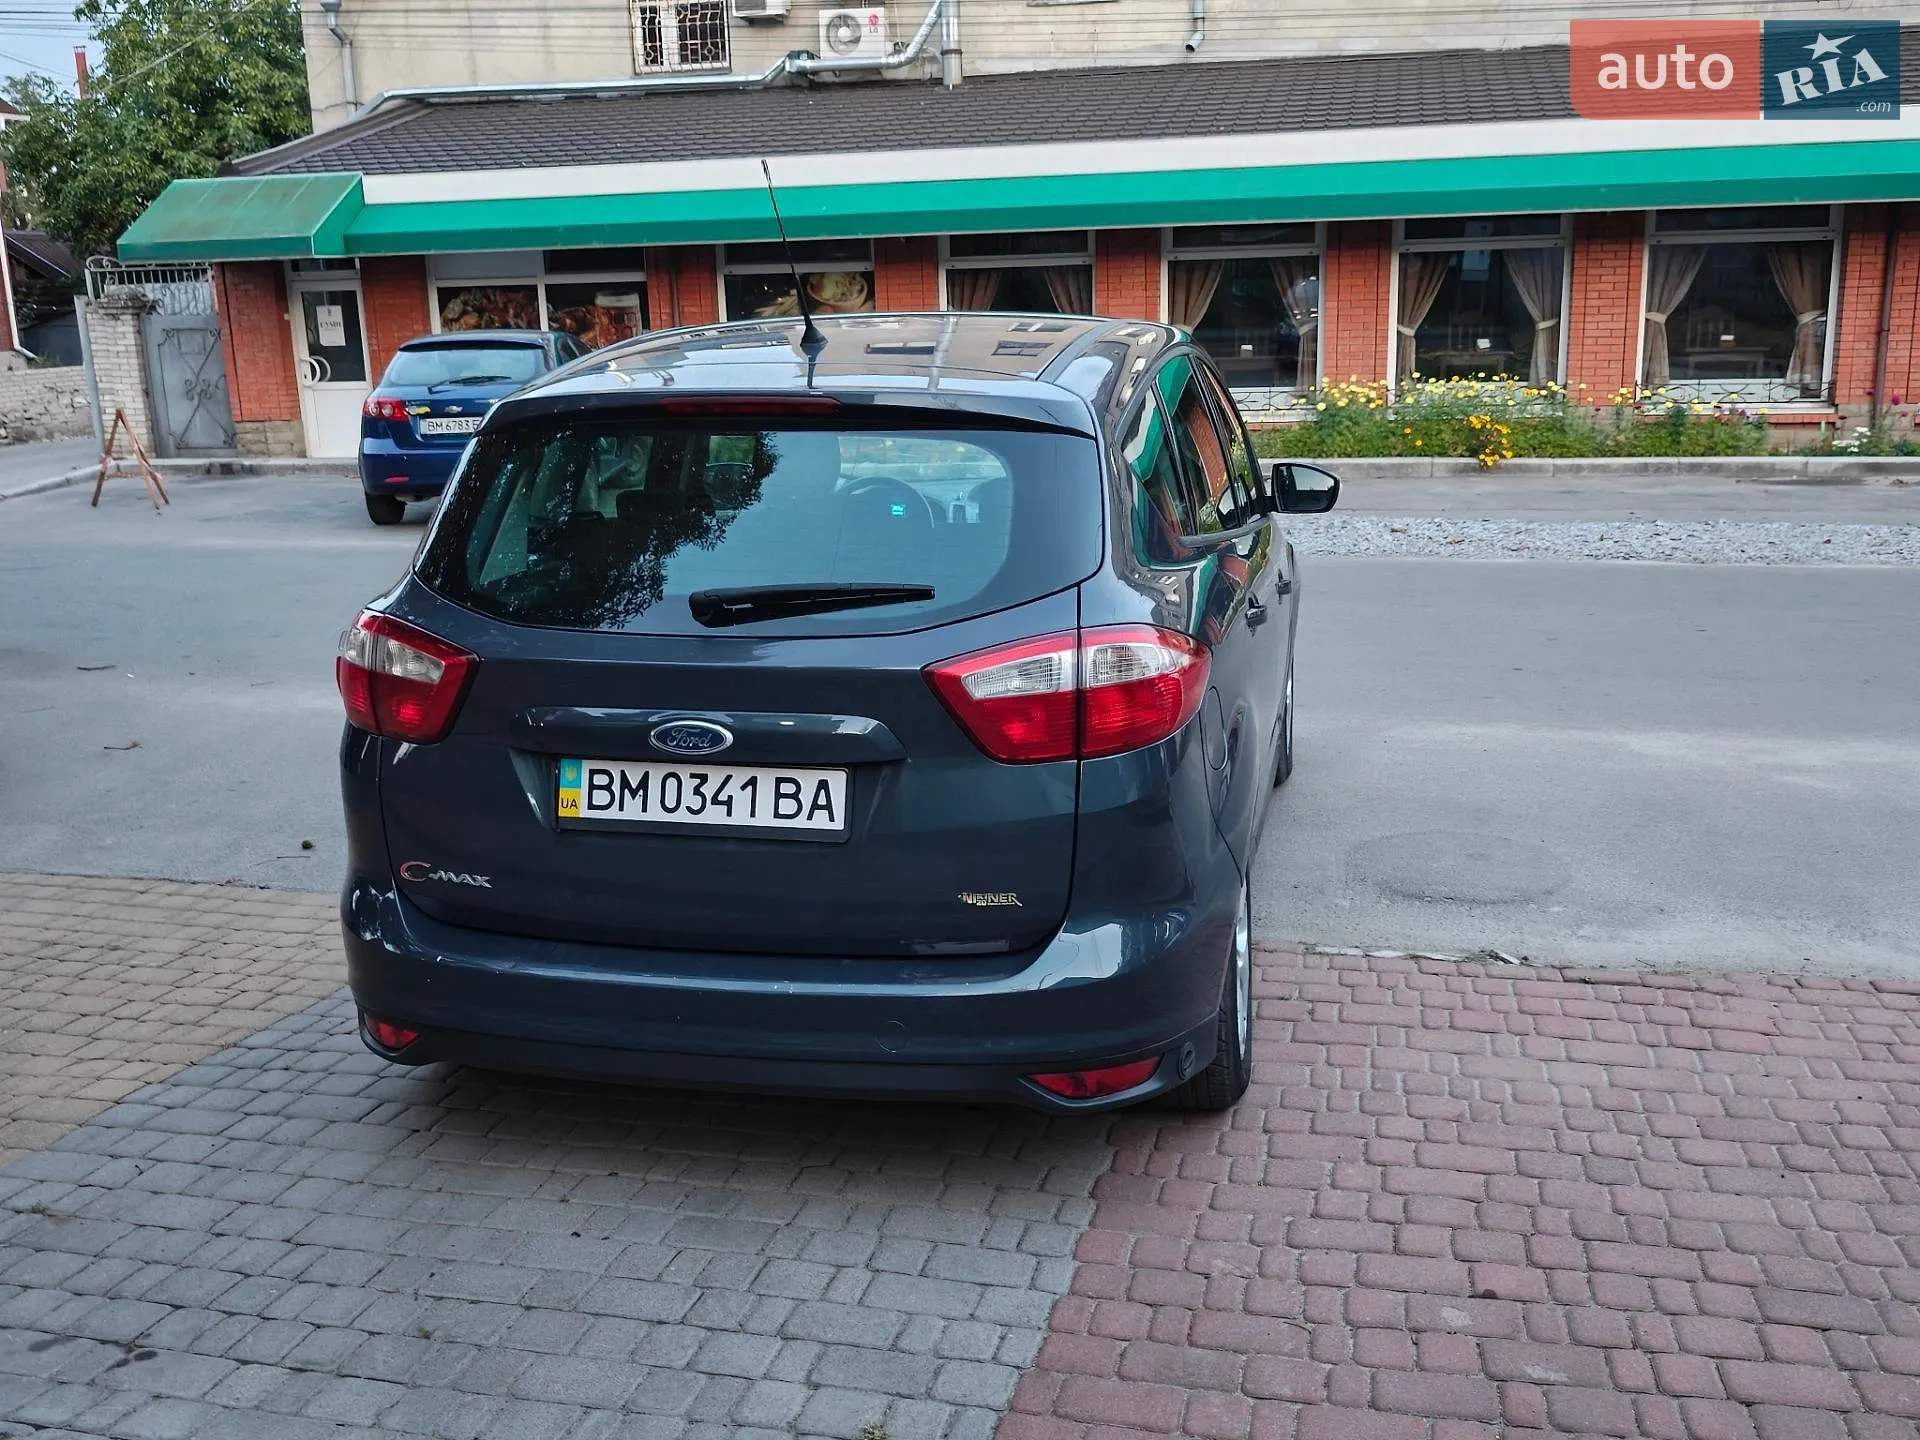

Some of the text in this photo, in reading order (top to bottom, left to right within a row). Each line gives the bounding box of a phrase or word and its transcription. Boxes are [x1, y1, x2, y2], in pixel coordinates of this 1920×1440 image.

[667, 727, 712, 748] Ford
[561, 798, 578, 810] UA
[587, 768, 836, 823] BM 0341 BA
